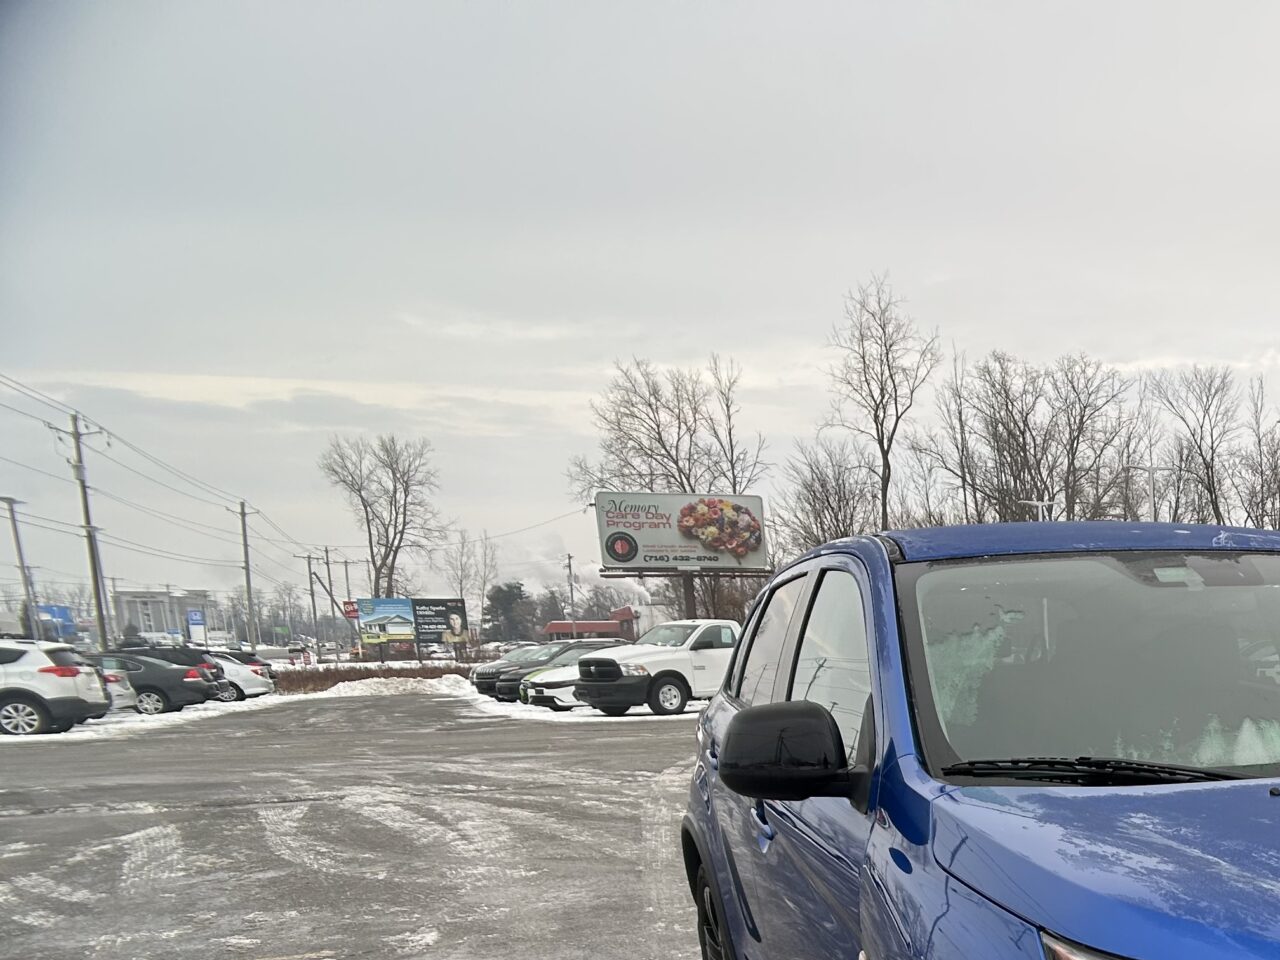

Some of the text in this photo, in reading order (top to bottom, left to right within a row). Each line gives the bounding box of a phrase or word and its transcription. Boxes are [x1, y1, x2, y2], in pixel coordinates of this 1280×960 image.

[601, 500, 659, 513] Memory
[606, 511, 671, 523] Care Day
[606, 520, 671, 530] Program
[643, 554, 669, 563] (716)
